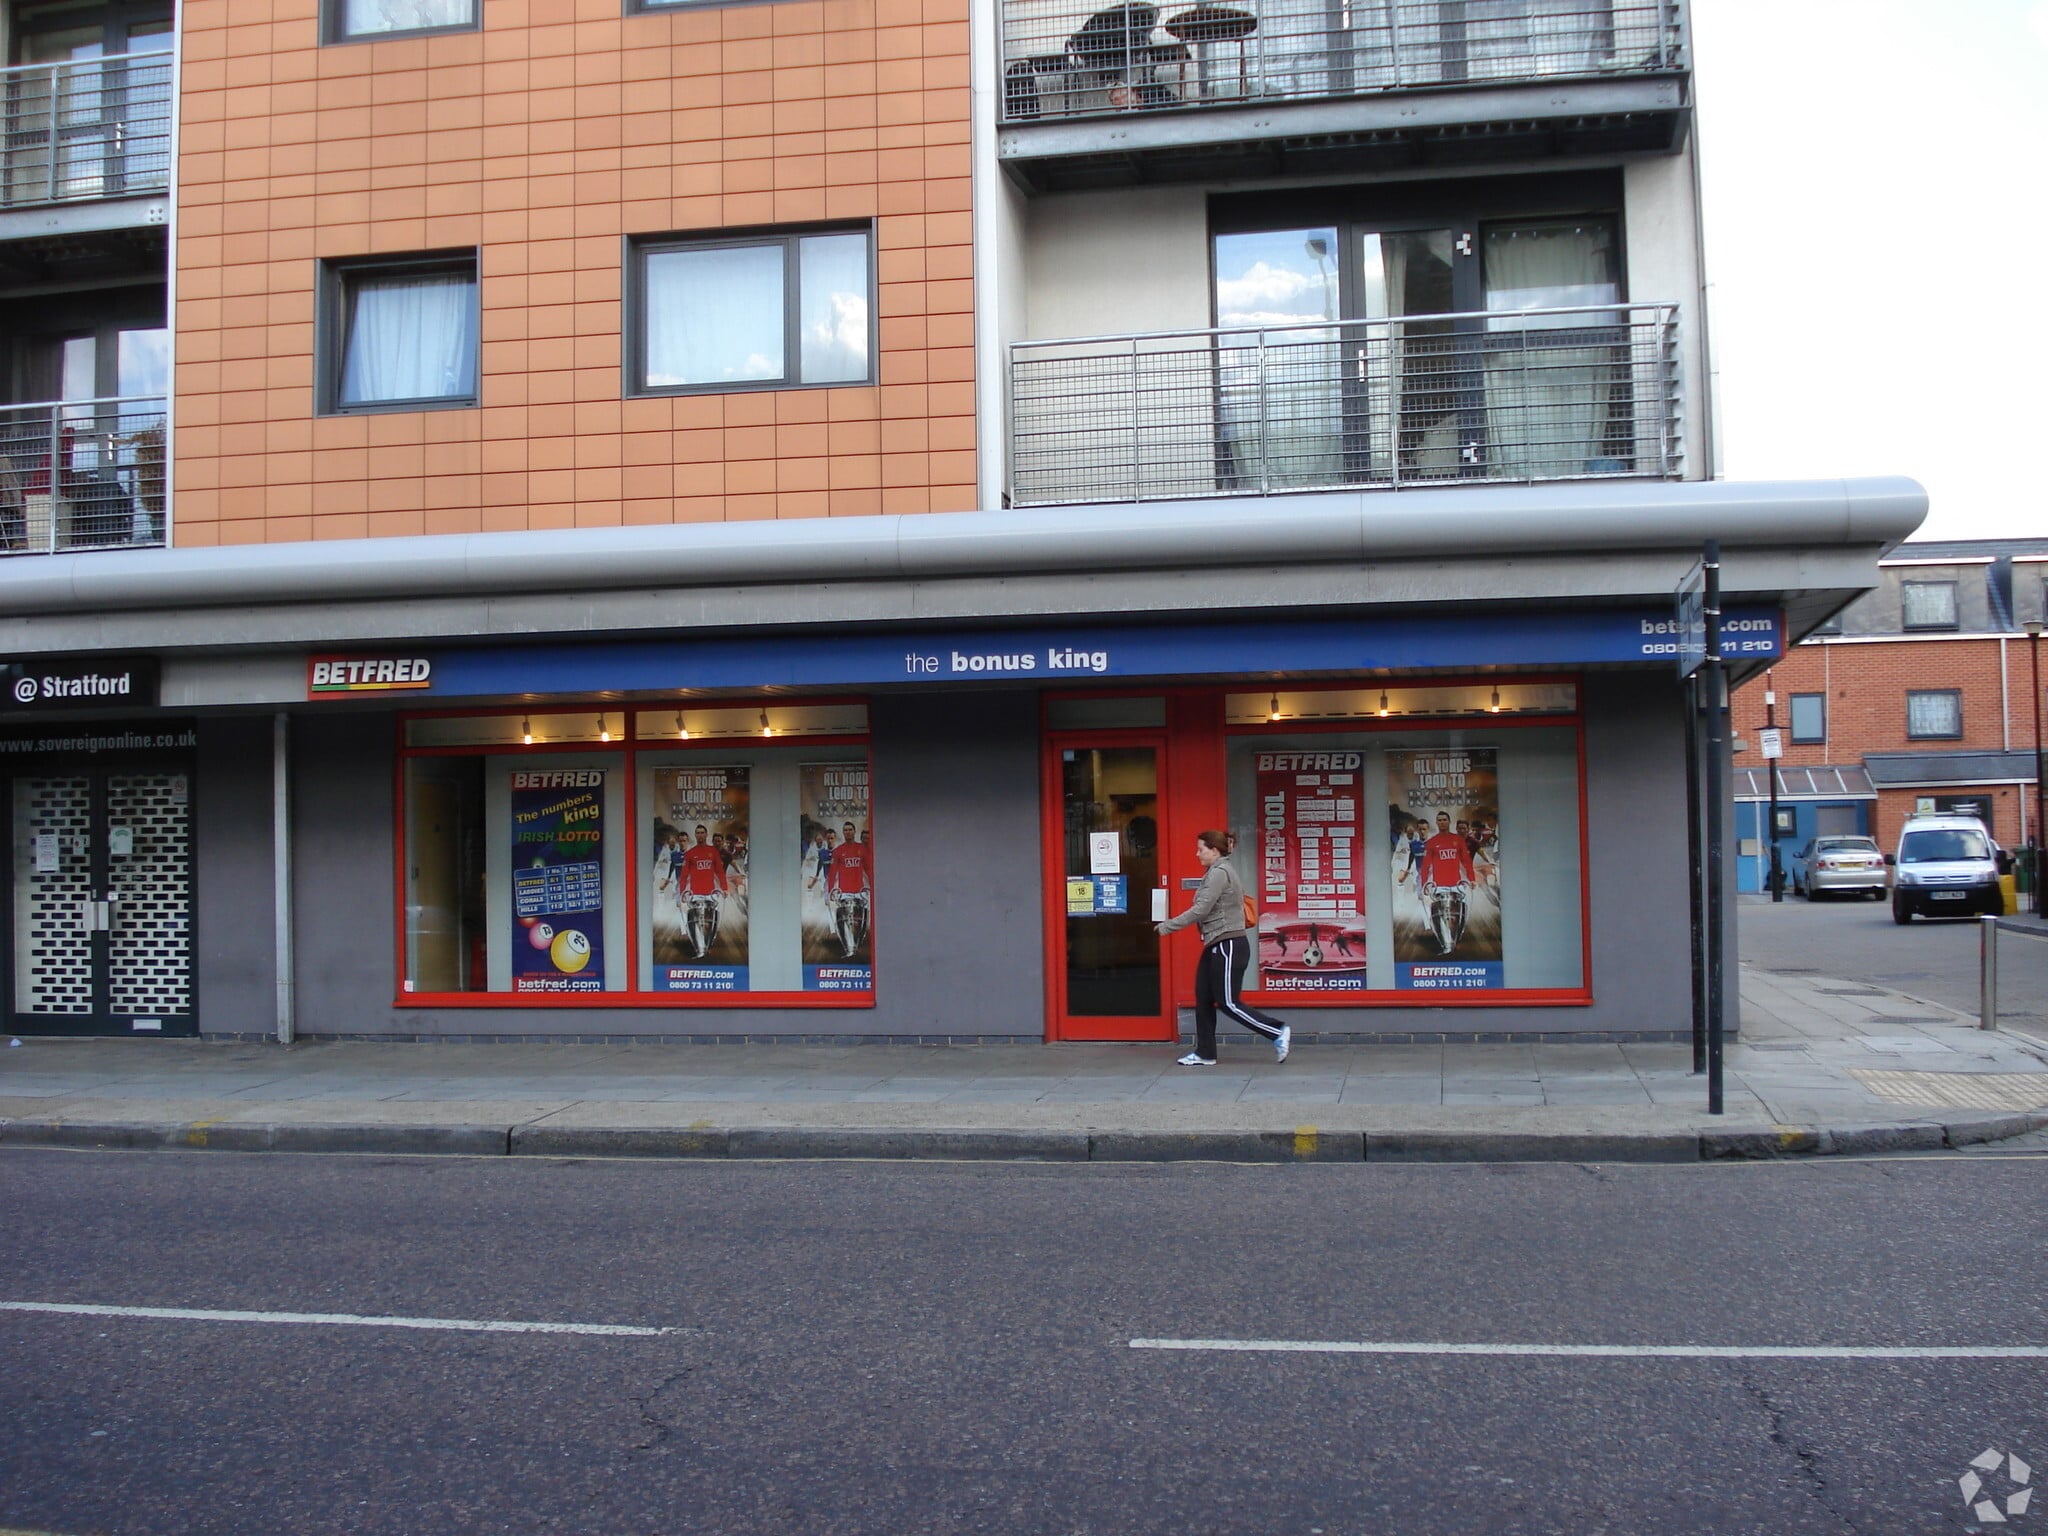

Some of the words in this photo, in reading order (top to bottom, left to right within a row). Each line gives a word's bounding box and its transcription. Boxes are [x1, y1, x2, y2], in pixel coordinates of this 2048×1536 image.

[1641, 619, 1772, 635] bet.com
[1742, 640, 1773, 652] 210
[905, 652, 939, 673] the
[951, 651, 1036, 672] bonus
[1048, 648, 1108, 672] king
[312, 659, 431, 685] BETFRED
[15, 677, 38, 703] @
[43, 672, 131, 698] Stratford
[1258, 753, 1361, 771] BETFRED
[1413, 759, 1432, 774] ALL
[1435, 758, 1471, 773] ROADS
[514, 771, 602, 788] BETFRED
[677, 776, 693, 790] ALL
[695, 775, 728, 790] ROADS
[824, 772, 839, 786] ALL
[842, 772, 869, 786] ROAD
[1450, 774, 1466, 788] TO
[709, 790, 722, 803] TO
[1407, 788, 1480, 808] ROME
[516, 811, 539, 824] The
[541, 792, 593, 816] numbers
[563, 804, 600, 824] king
[671, 803, 734, 820] ROME
[817, 801, 868, 817] ROM
[518, 831, 555, 842] IRISH
[557, 830, 600, 842] LOTTO
[1264, 790, 1287, 903] LIVERPOOL
[517, 979, 600, 988] betfred.com
[669, 981, 690, 989] 0800
[691, 981, 702, 989] 73
[704, 981, 713, 989] 11
[1265, 977, 1361, 987] betfred.com
[1413, 979, 1436, 987] 0800
[1439, 979, 1450, 987] 73
[1452, 979, 1463, 987] 11
